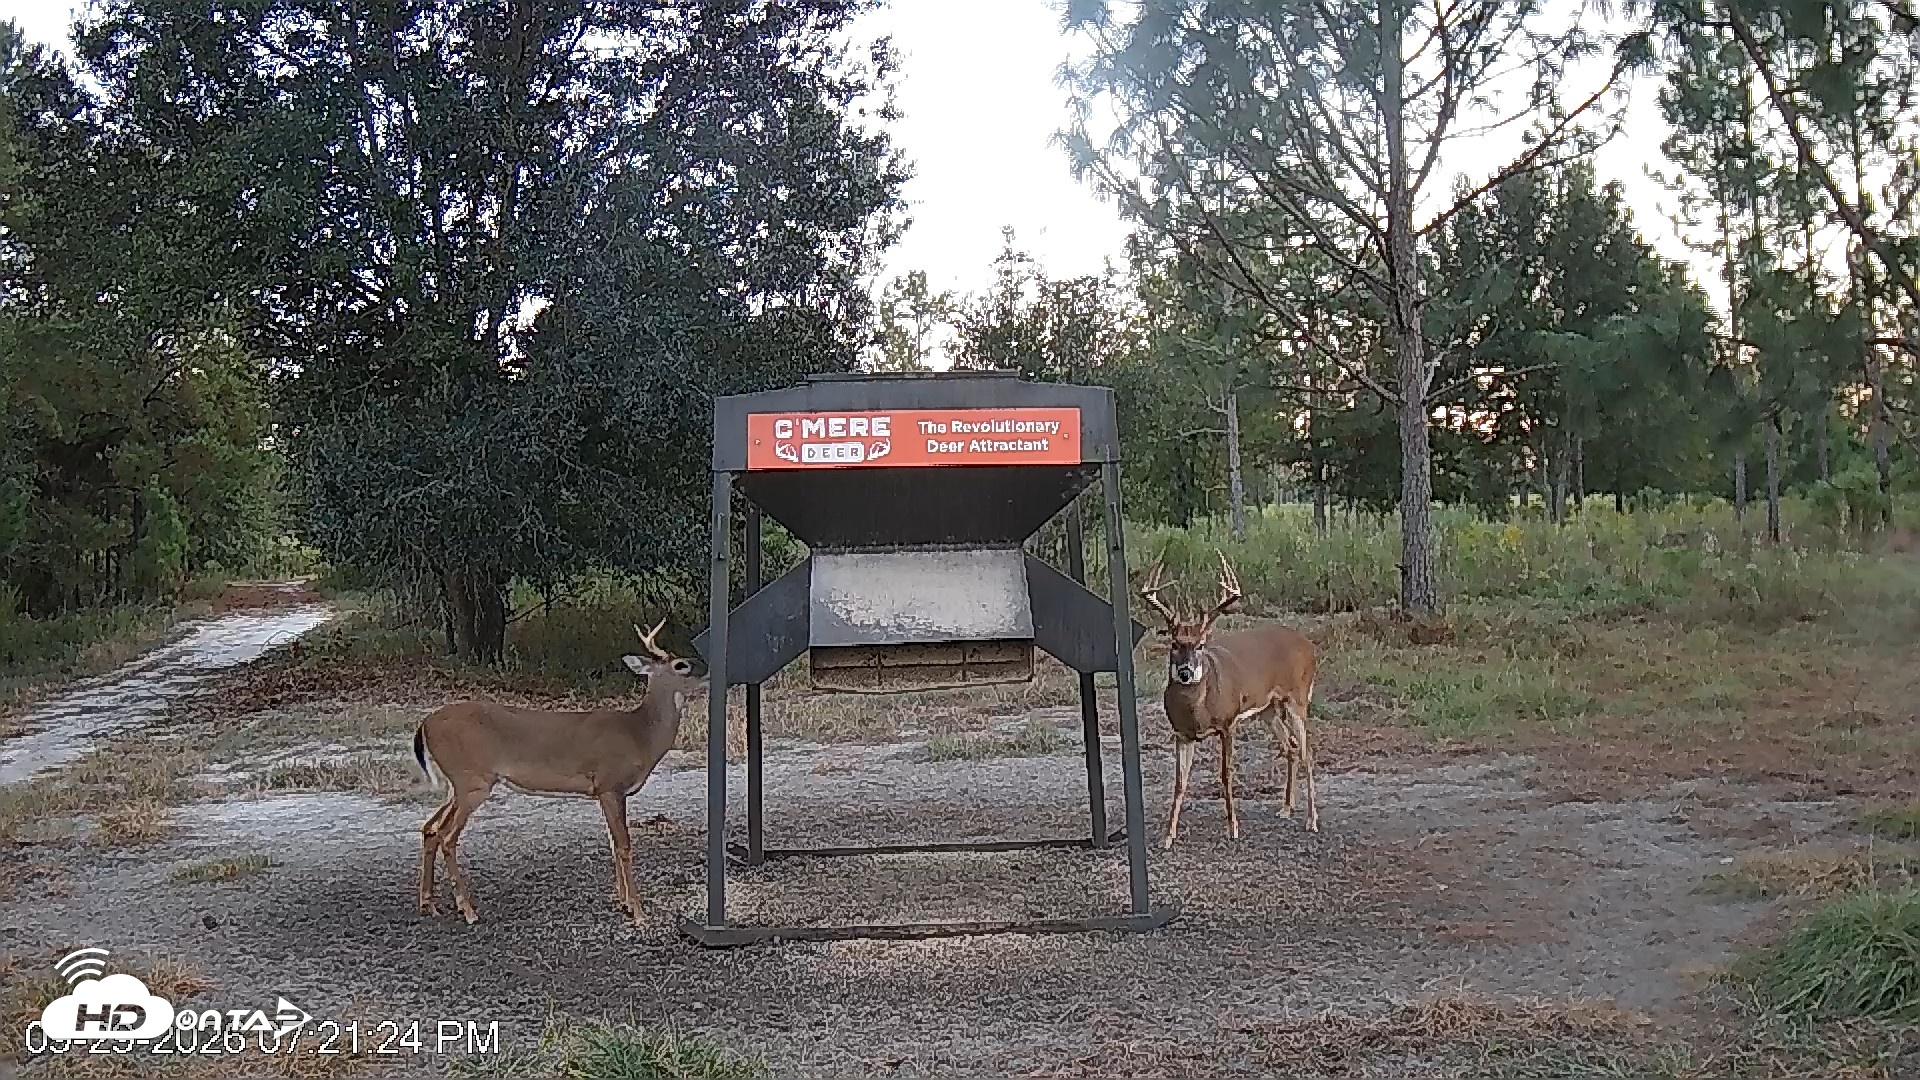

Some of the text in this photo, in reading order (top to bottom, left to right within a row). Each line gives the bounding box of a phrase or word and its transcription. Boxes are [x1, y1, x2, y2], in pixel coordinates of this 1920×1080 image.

[775, 417, 891, 439] C'MERE
[917, 418, 1061, 435] The Revolutionary
[807, 447, 859, 459] DEER
[927, 437, 1049, 453] Deer Attractant
